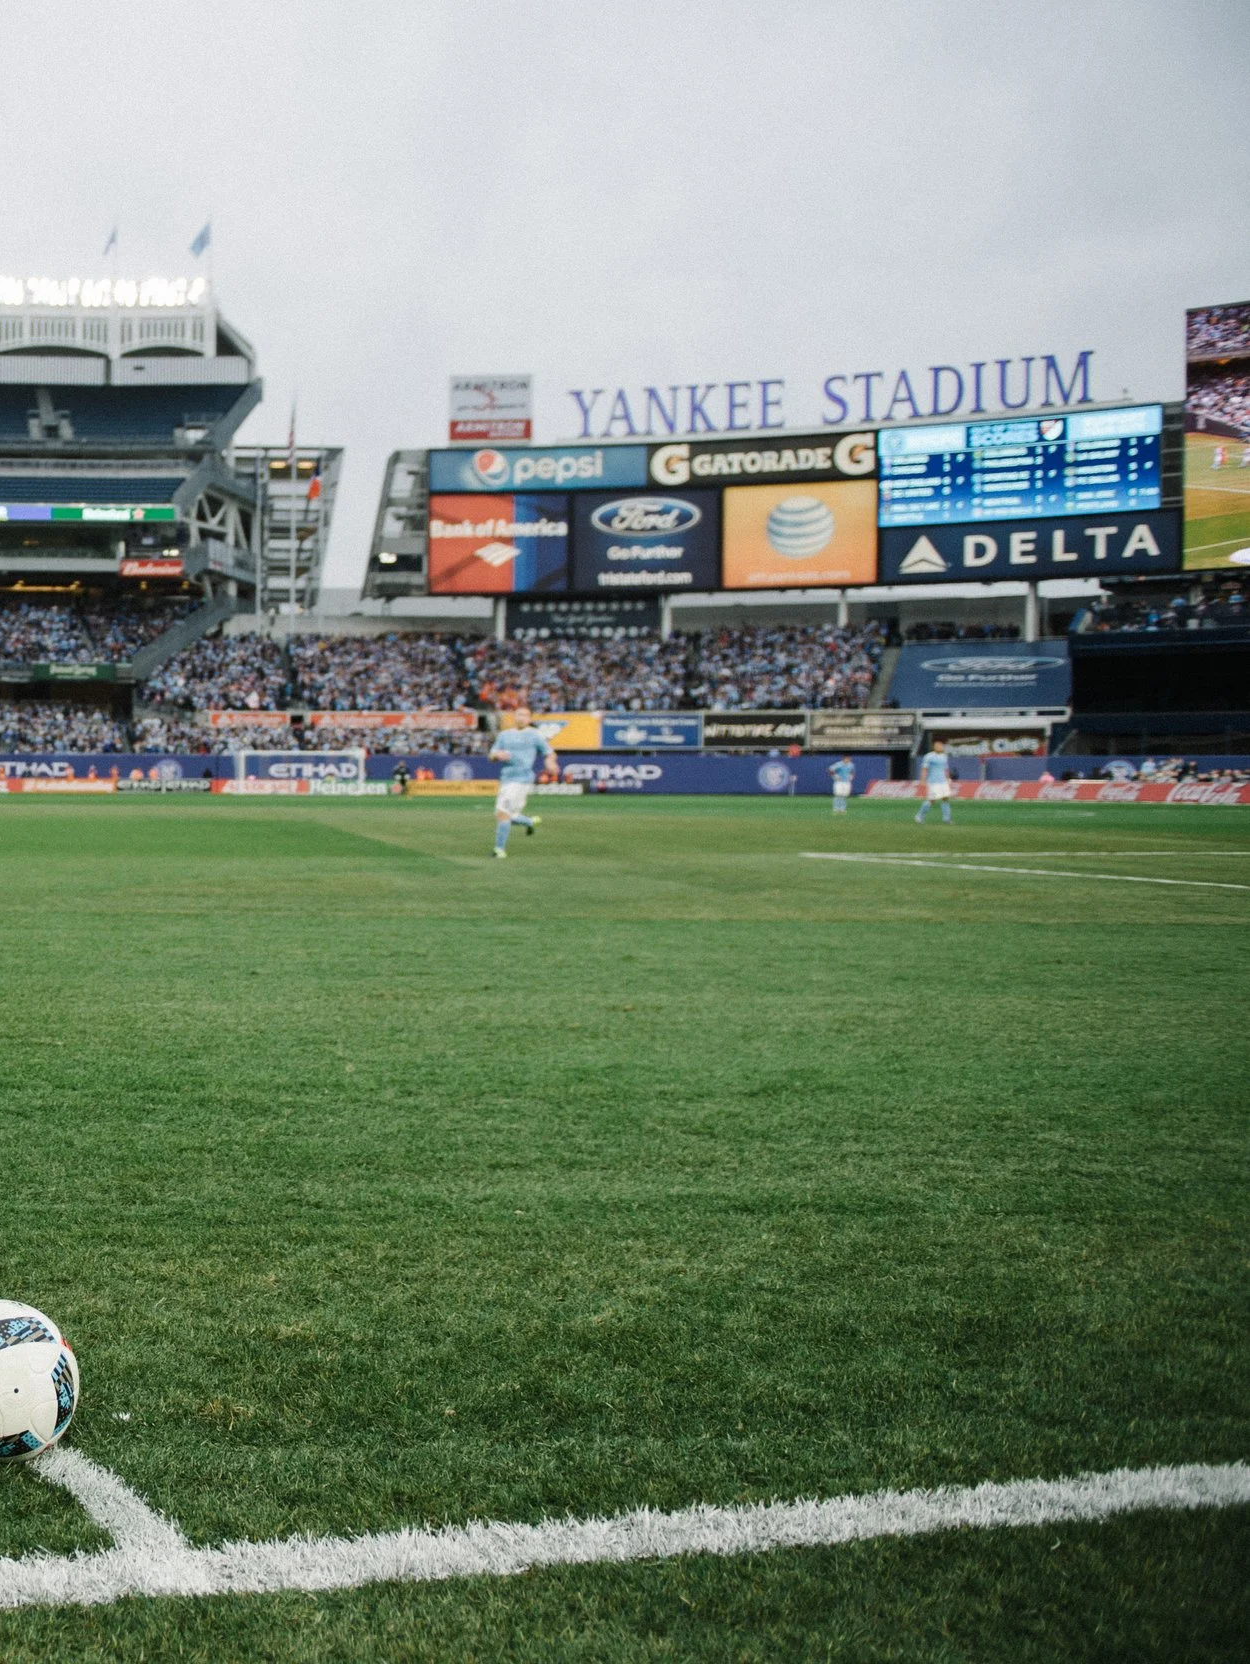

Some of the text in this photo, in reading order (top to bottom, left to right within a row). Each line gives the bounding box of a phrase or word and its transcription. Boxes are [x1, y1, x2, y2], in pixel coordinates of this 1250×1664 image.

[569, 350, 1095, 438] YANKEE STADIUM
[513, 450, 603, 485] pepsi
[692, 448, 833, 477] GATORADE
[611, 501, 681, 531] Ford
[430, 517, 568, 537] Bank of America
[607, 545, 683, 560] Go Further
[963, 524, 1161, 568] DELTA
[948, 659, 1038, 671] Ford
[268, 762, 359, 779] ETIHAD
[563, 763, 662, 781] ETIHAD
[309, 779, 388, 796] Heineken
